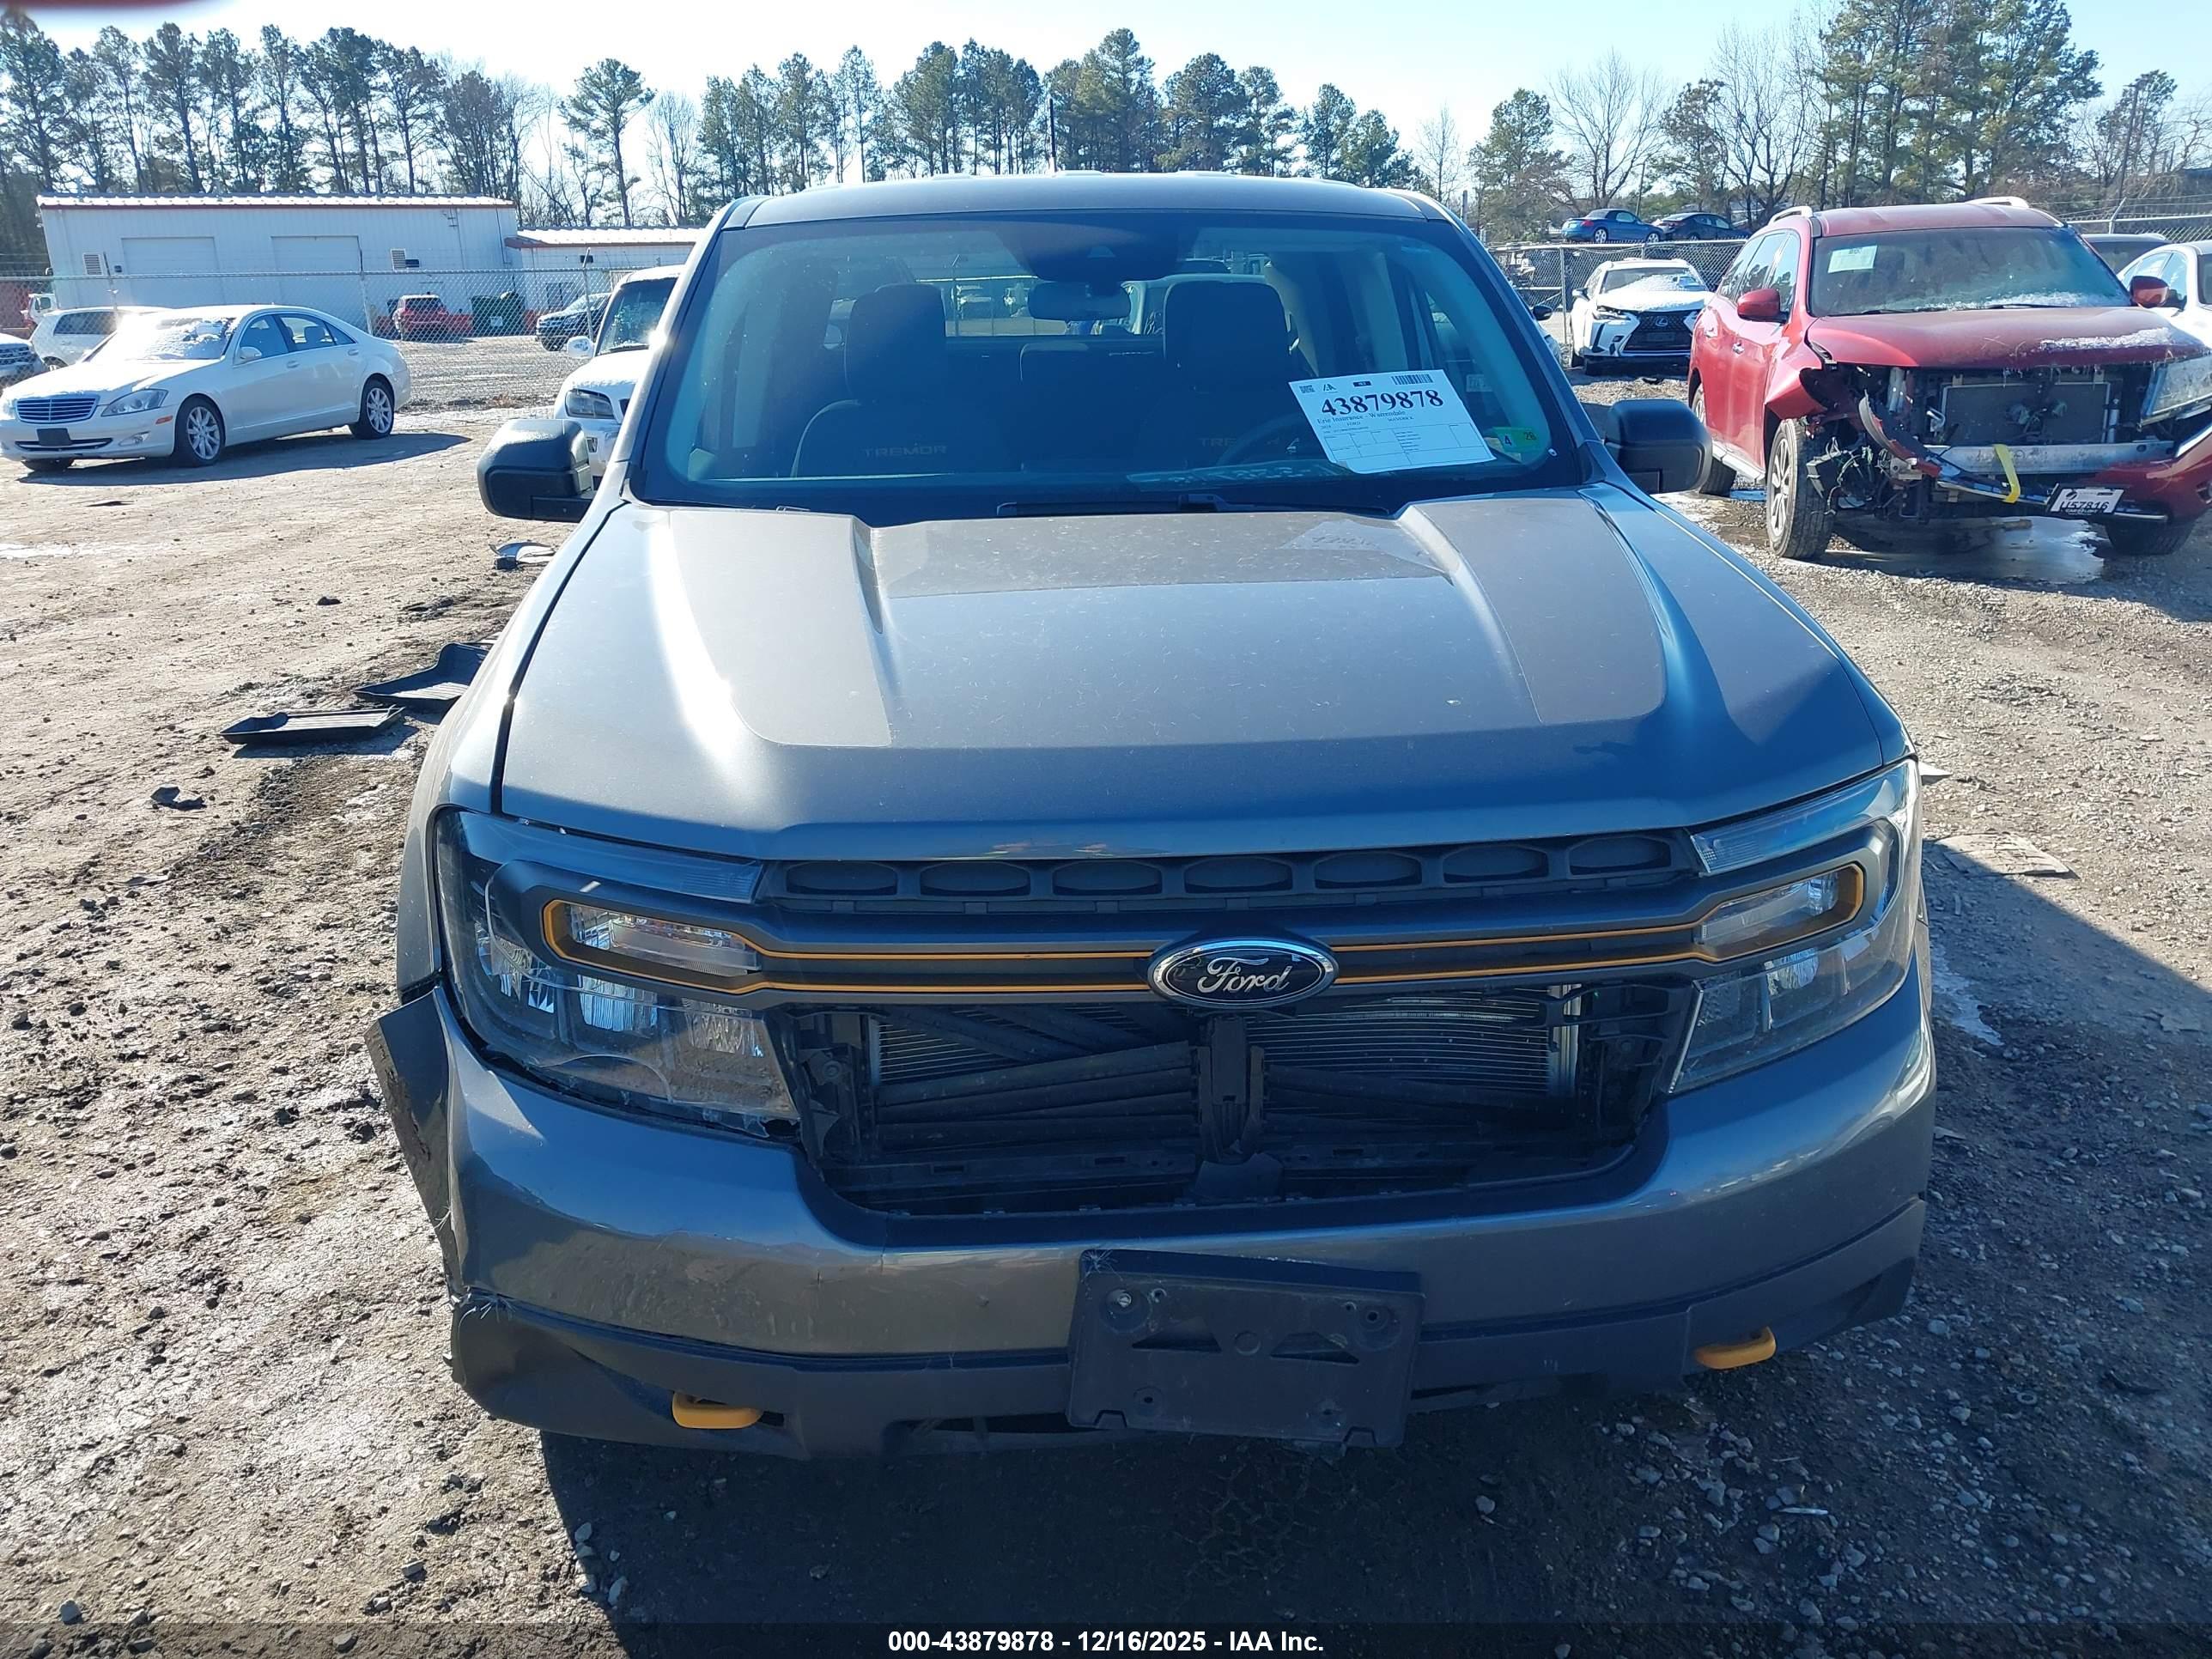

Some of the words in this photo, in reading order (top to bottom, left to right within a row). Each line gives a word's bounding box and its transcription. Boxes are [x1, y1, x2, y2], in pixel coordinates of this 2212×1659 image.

[1322, 389, 1444, 416] 43879878
[1504, 435, 1512, 446] 4
[860, 445, 947, 459] TREMOR
[1196, 957, 1292, 994] Ford
